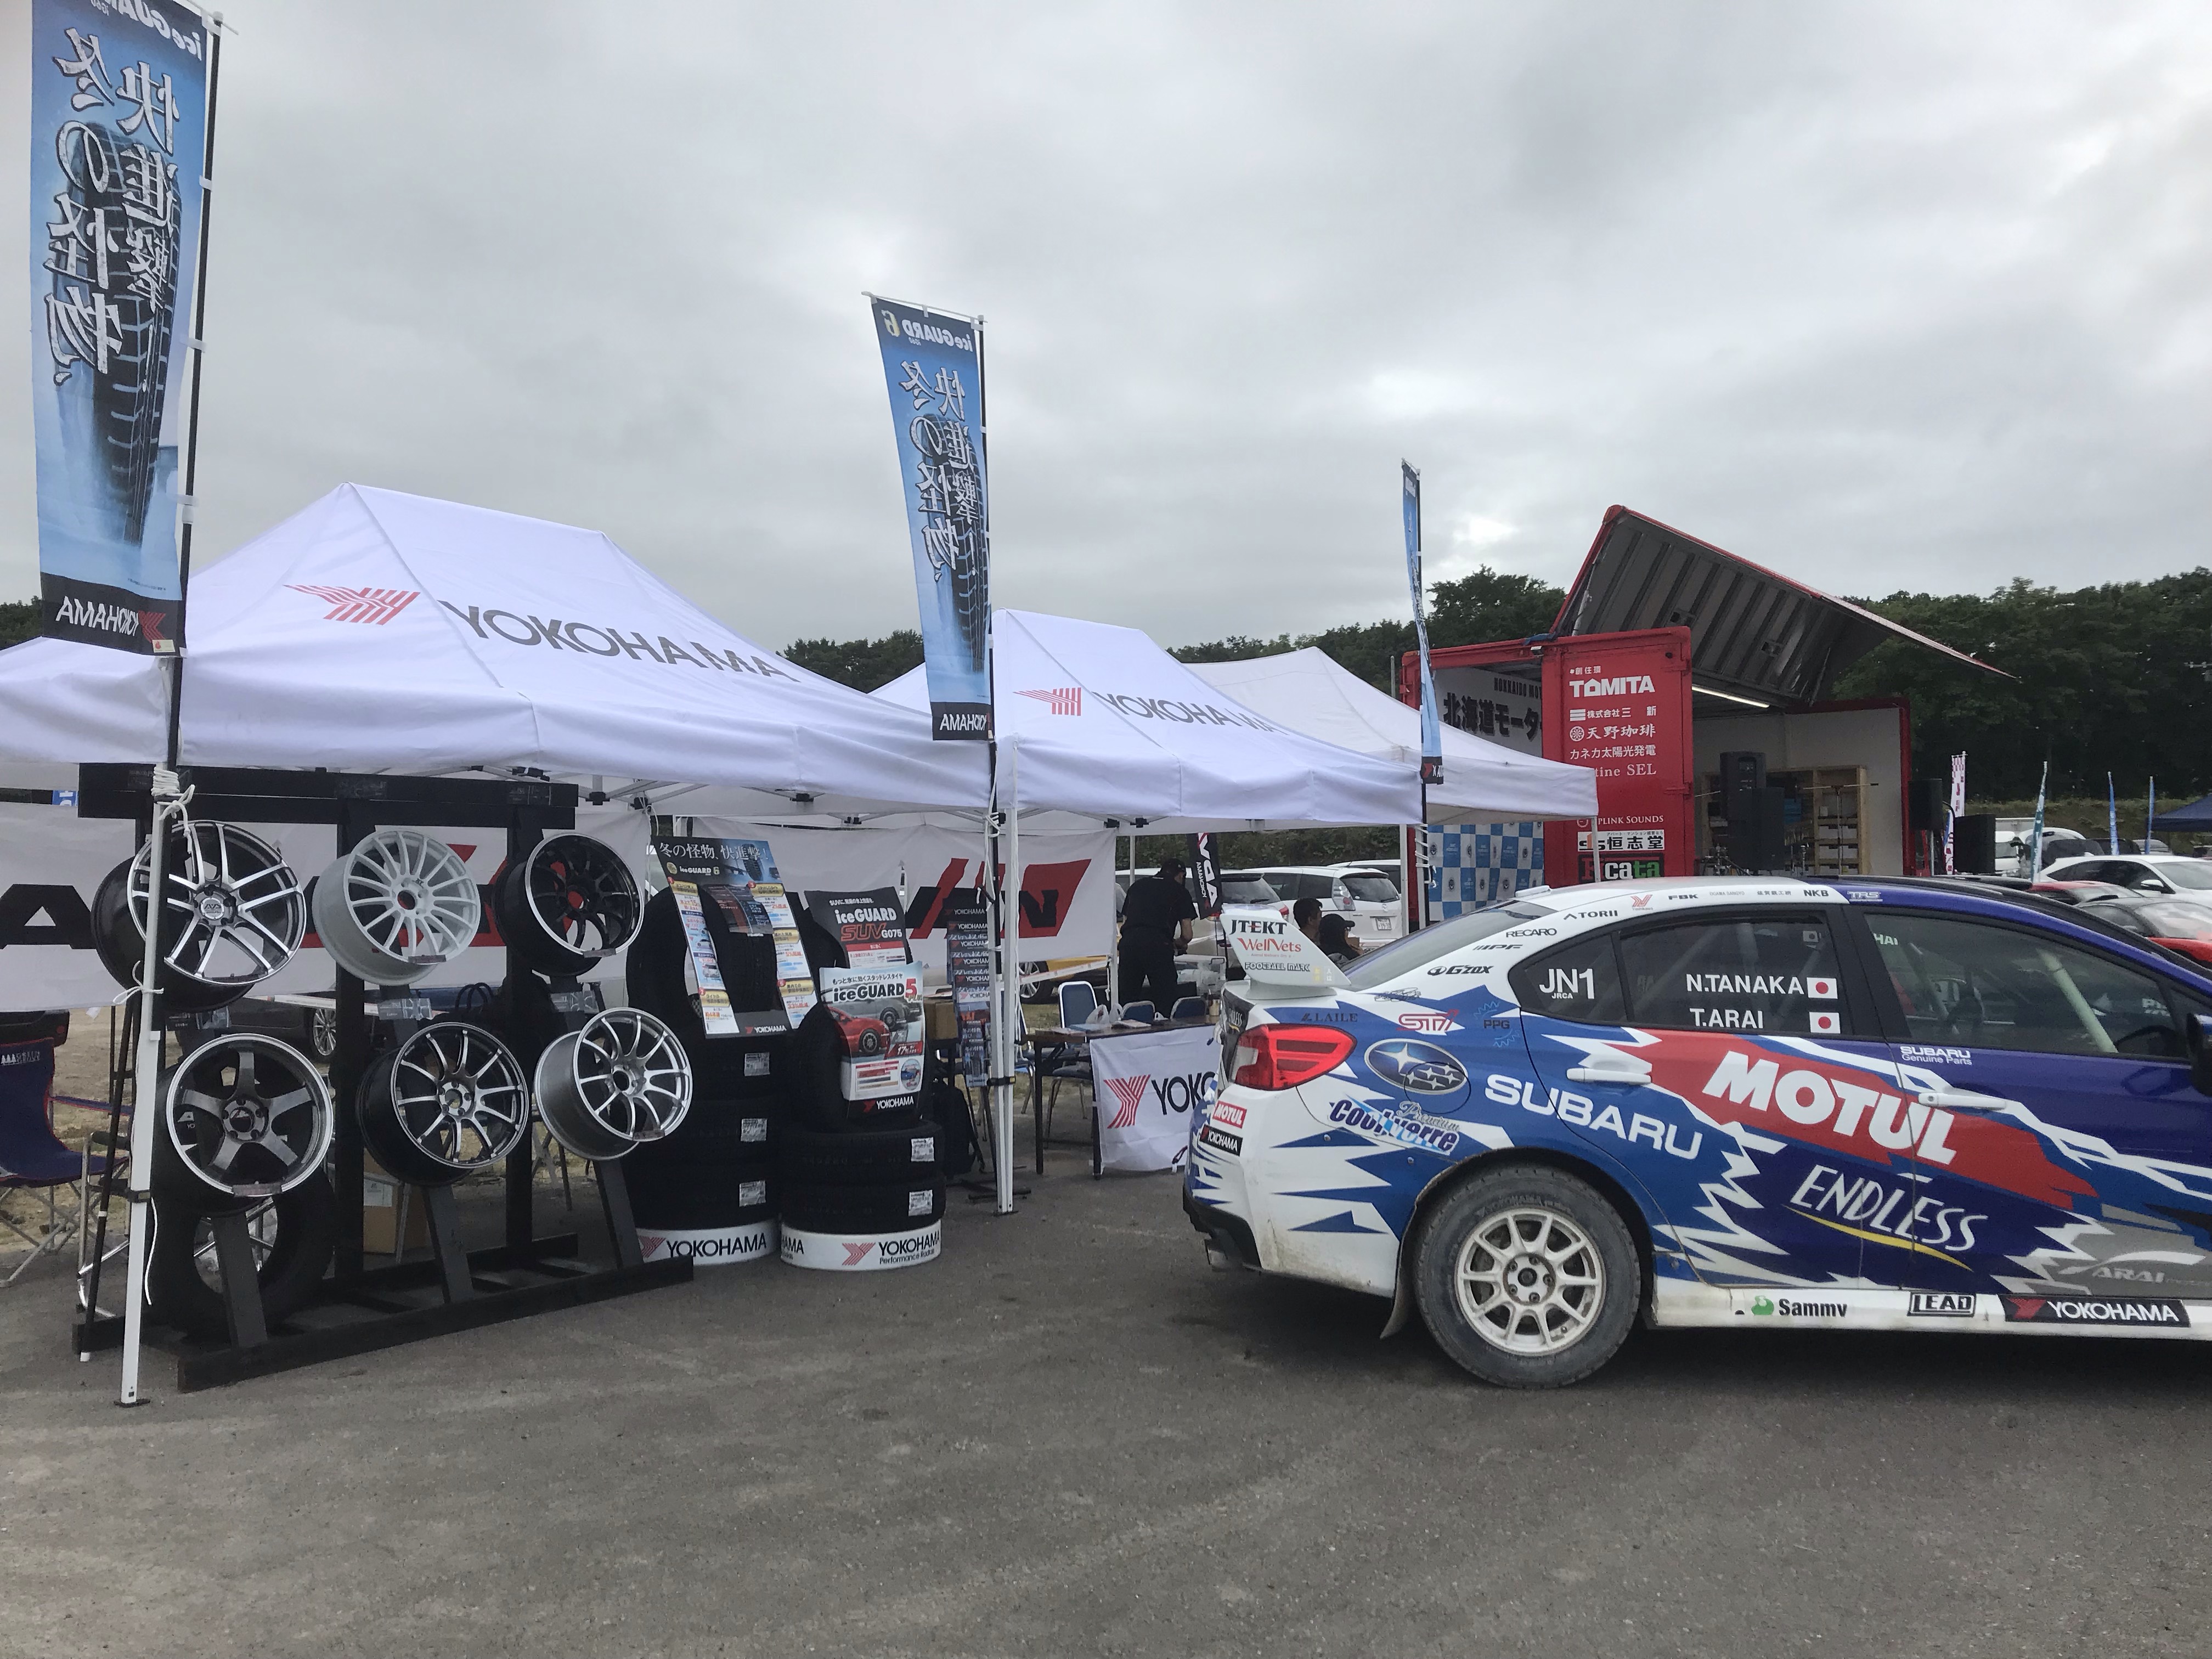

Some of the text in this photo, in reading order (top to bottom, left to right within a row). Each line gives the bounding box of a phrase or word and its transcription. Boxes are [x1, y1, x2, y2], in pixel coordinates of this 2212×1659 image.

[437, 600, 801, 683] YOKOHAMA
[1494, 677, 1527, 697] HOKKAIDO
[1569, 675, 1656, 698] TOMITA
[1443, 692, 1542, 742] 北海道モータ
[1586, 723, 1656, 740] 天野珈琲
[1570, 744, 1656, 760] カネカ太陽光発電
[1595, 763, 1657, 777] tine SEL
[1598, 816, 1624, 825] PLINK
[1607, 836, 1663, 850] 恒志堂
[834, 907, 897, 924] iceGUARD
[1578, 910, 1618, 919] TORII
[840, 923, 902, 942] SUV G075
[1229, 919, 1287, 935] JTEKT
[1506, 928, 1557, 938] RECARO
[833, 978, 917, 1002] iceGUARD 5
[1539, 968, 1594, 1000] JN1
[1686, 974, 1805, 996] N.TANAKA
[1315, 1012, 1357, 1023] LAILE
[1483, 1019, 1510, 1029] PPG
[1690, 1008, 1764, 1030] T.ARAI
[754, 1025, 787, 1034] YOKOHAMA
[1900, 1046, 1971, 1058] SUBARU
[1901, 1053, 1972, 1065] Genuine Parts
[876, 1096, 914, 1110] YOKOHAMA
[1702, 1050, 1957, 1166] MOTUL
[1214, 1103, 1244, 1125] MOTUL
[1485, 1073, 1703, 1160] SUBARU
[1207, 1130, 1238, 1152] YOKOHAMA
[1789, 1163, 1988, 1251] ENDLESS
[666, 1232, 767, 1257] YOKOHAMA
[878, 1229, 940, 1256] YOKOHAMA
[2092, 1266, 2165, 1284] ARAI
[2046, 1299, 2180, 1322] YOKOHAMA
